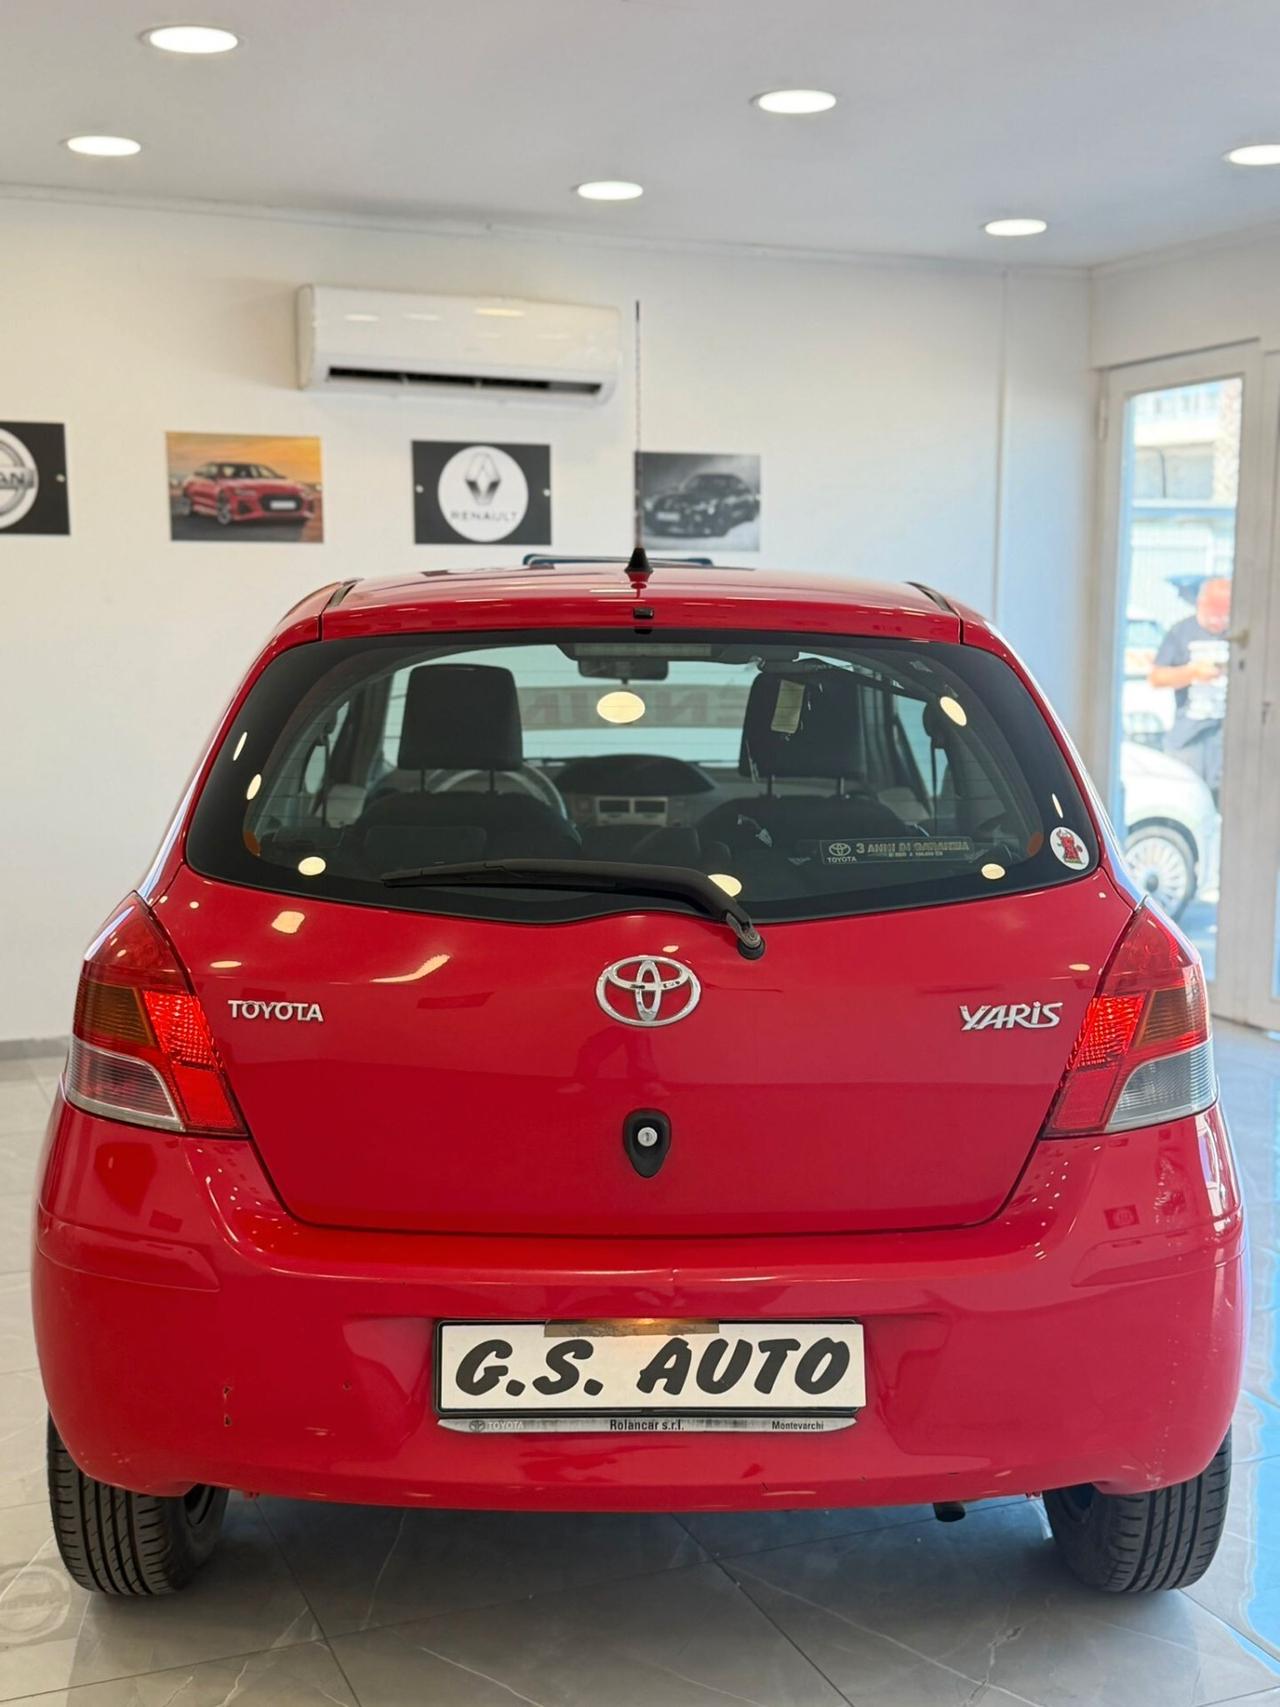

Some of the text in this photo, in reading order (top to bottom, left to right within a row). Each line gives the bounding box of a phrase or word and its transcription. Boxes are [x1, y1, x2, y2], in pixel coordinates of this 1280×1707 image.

[451, 511, 518, 521] RENAULT
[856, 843, 865, 854] 3
[228, 1000, 324, 1022] TOYOTA
[455, 1337, 851, 1397] G.S. AUTO
[487, 1421, 525, 1430] TOYOTA
[610, 1419, 659, 1431] Rolancar
[771, 1420, 824, 1430] Montevarchi
